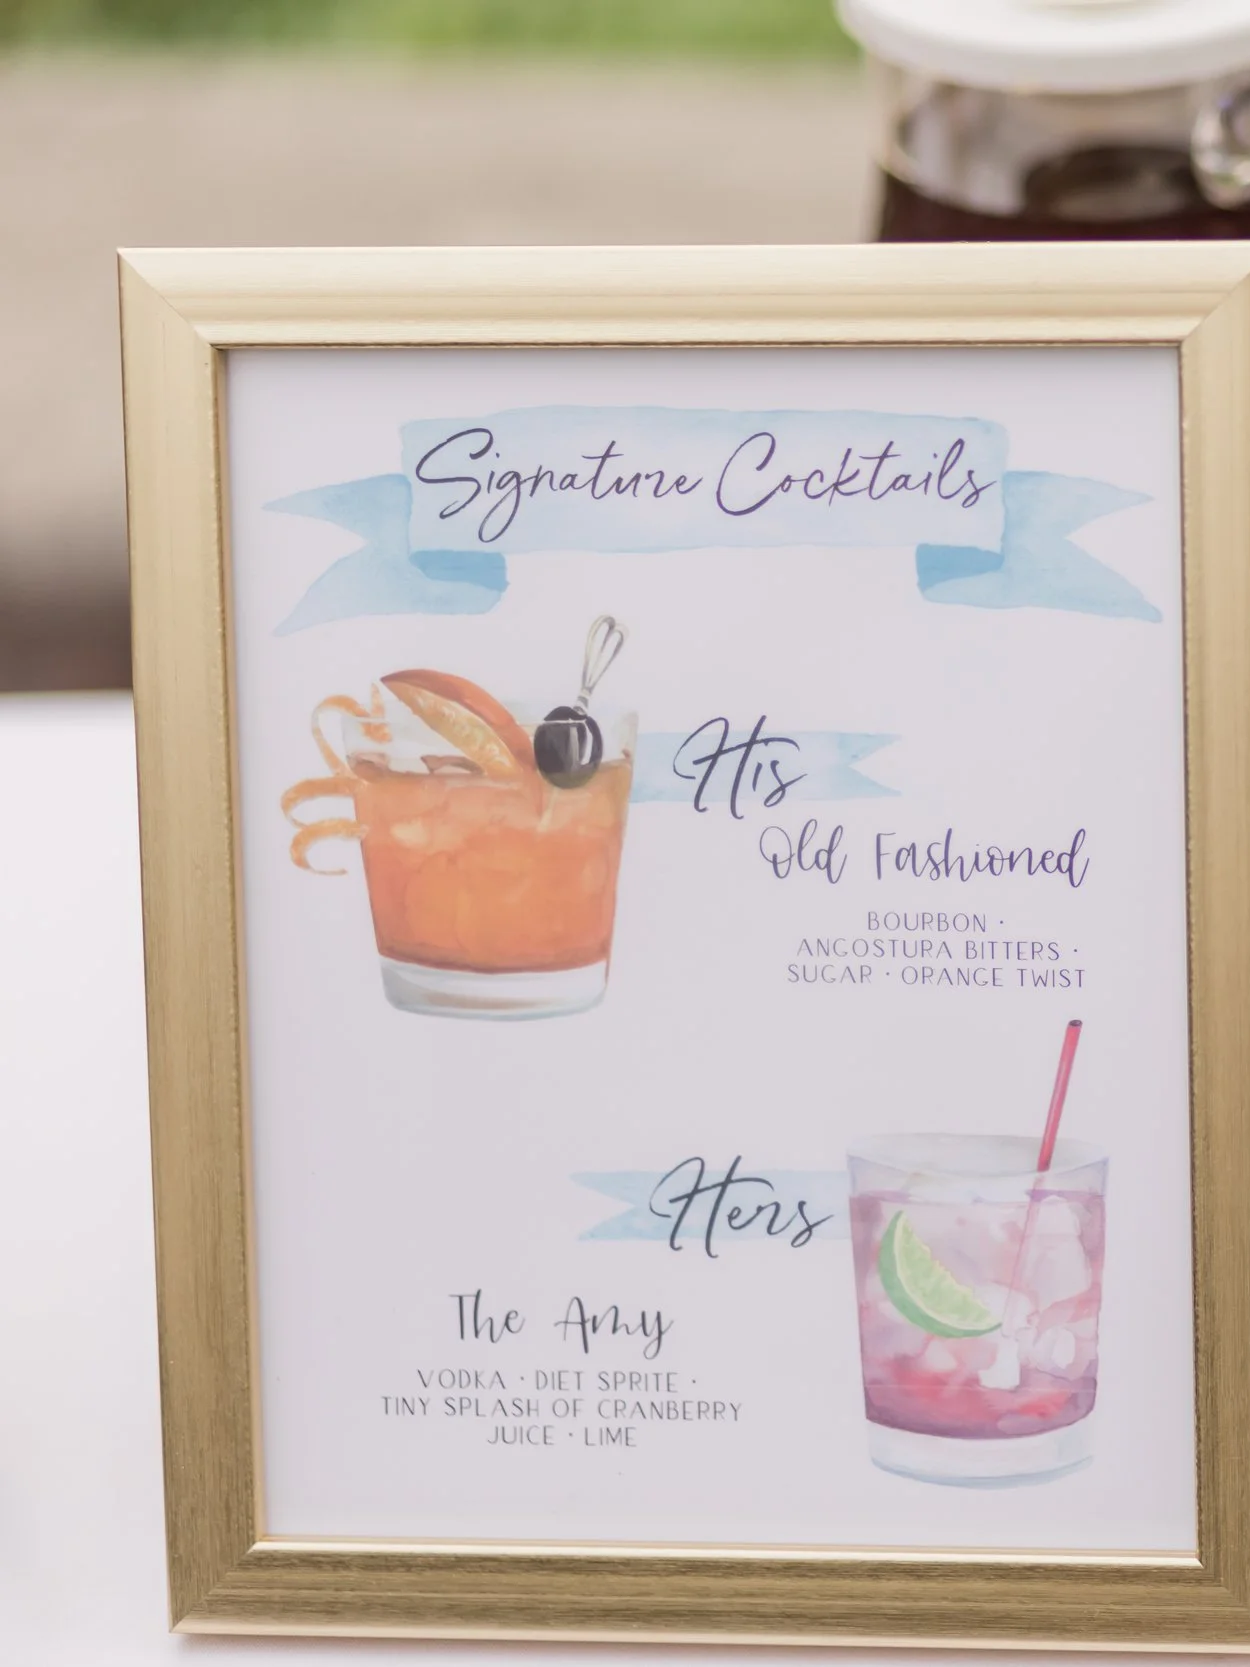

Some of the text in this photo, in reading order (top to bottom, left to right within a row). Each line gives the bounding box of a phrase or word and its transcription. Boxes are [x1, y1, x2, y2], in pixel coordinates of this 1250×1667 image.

[415, 427, 997, 542] Signature Cocktails
[673, 714, 808, 820] His
[759, 818, 1090, 888] Old Fashioned
[867, 911, 987, 933] BOURBON
[796, 938, 1060, 962] ANGOSTURA BITTERS
[787, 964, 1086, 988] SUGAR ORANGE TWIST
[649, 1155, 834, 1258] Hers
[448, 1288, 674, 1360] The Amy
[417, 1368, 678, 1393] VODKA DIET SPRITE
[381, 1396, 742, 1423] TINY SPLASH OF CRANBERRY
[487, 1425, 637, 1448] JUICE LIME
